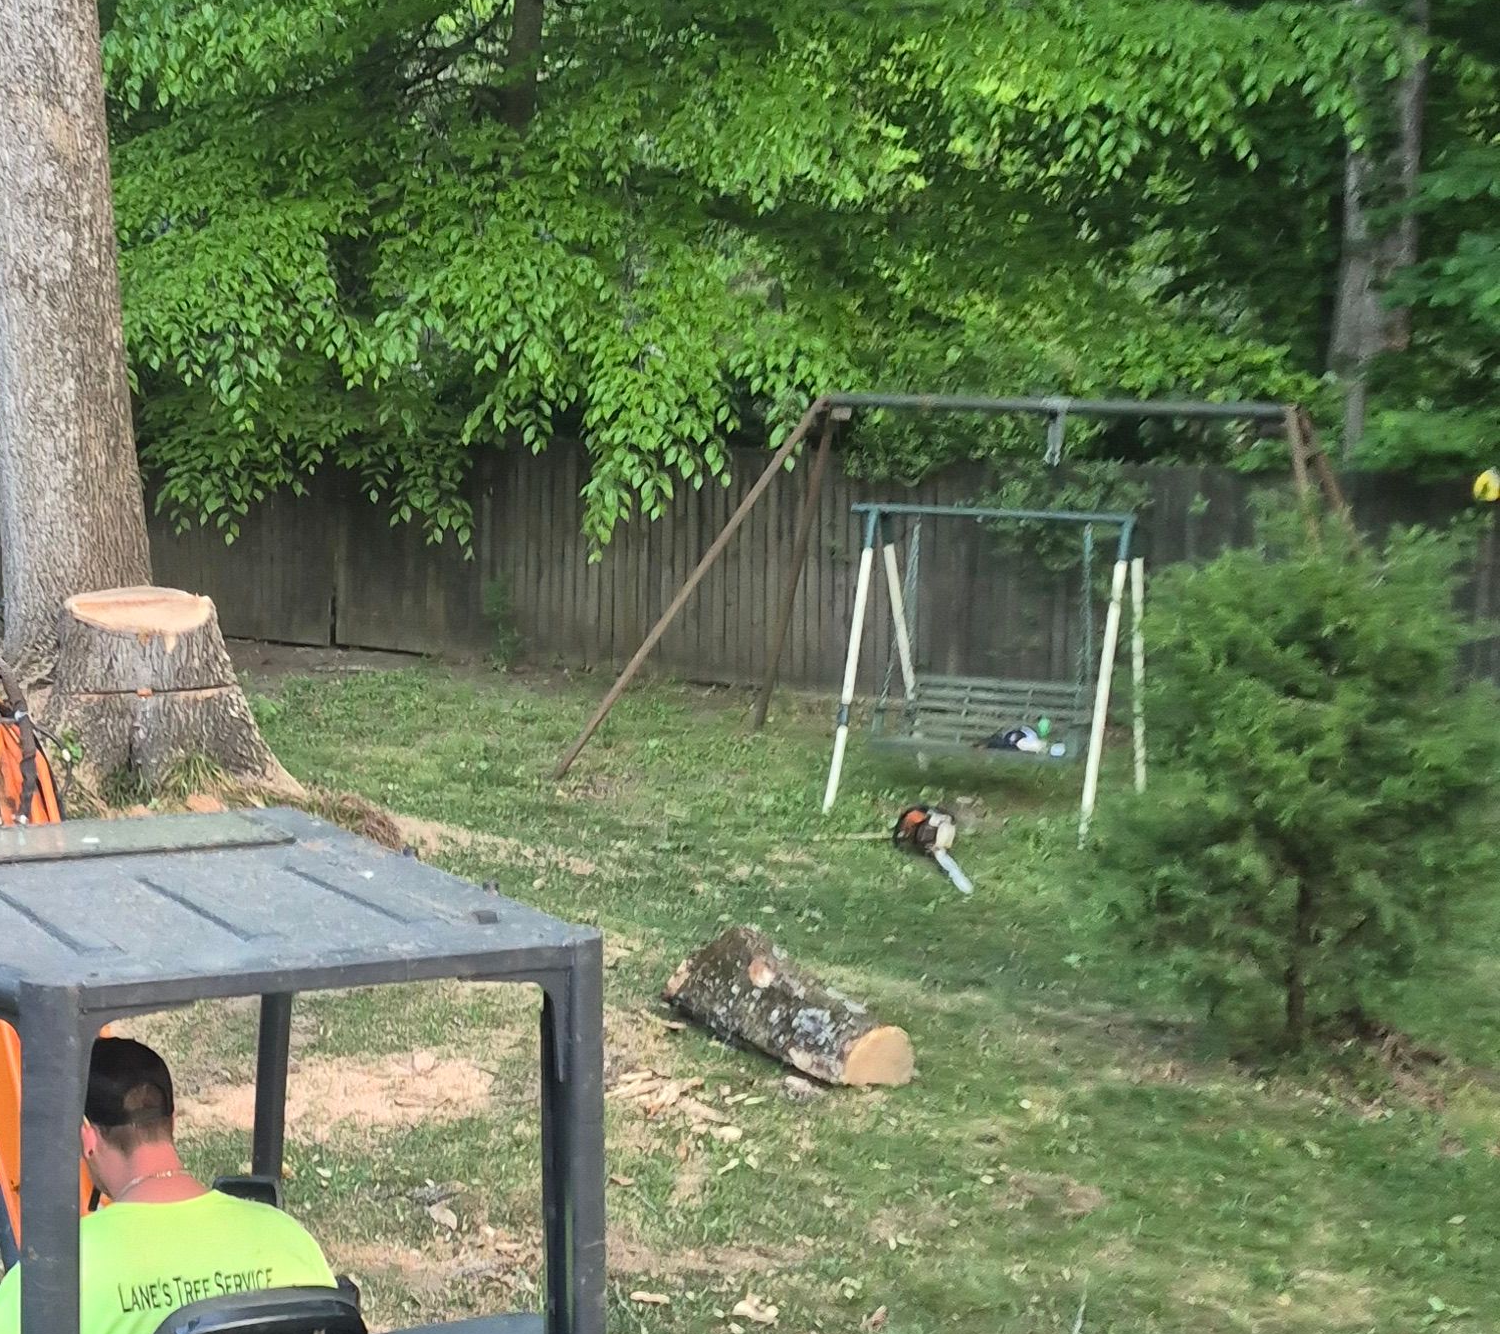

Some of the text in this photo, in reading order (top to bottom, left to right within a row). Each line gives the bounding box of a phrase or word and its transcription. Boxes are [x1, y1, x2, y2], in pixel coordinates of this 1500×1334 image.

[118, 1268, 273, 1313] LANE'S TREE SERVICE
